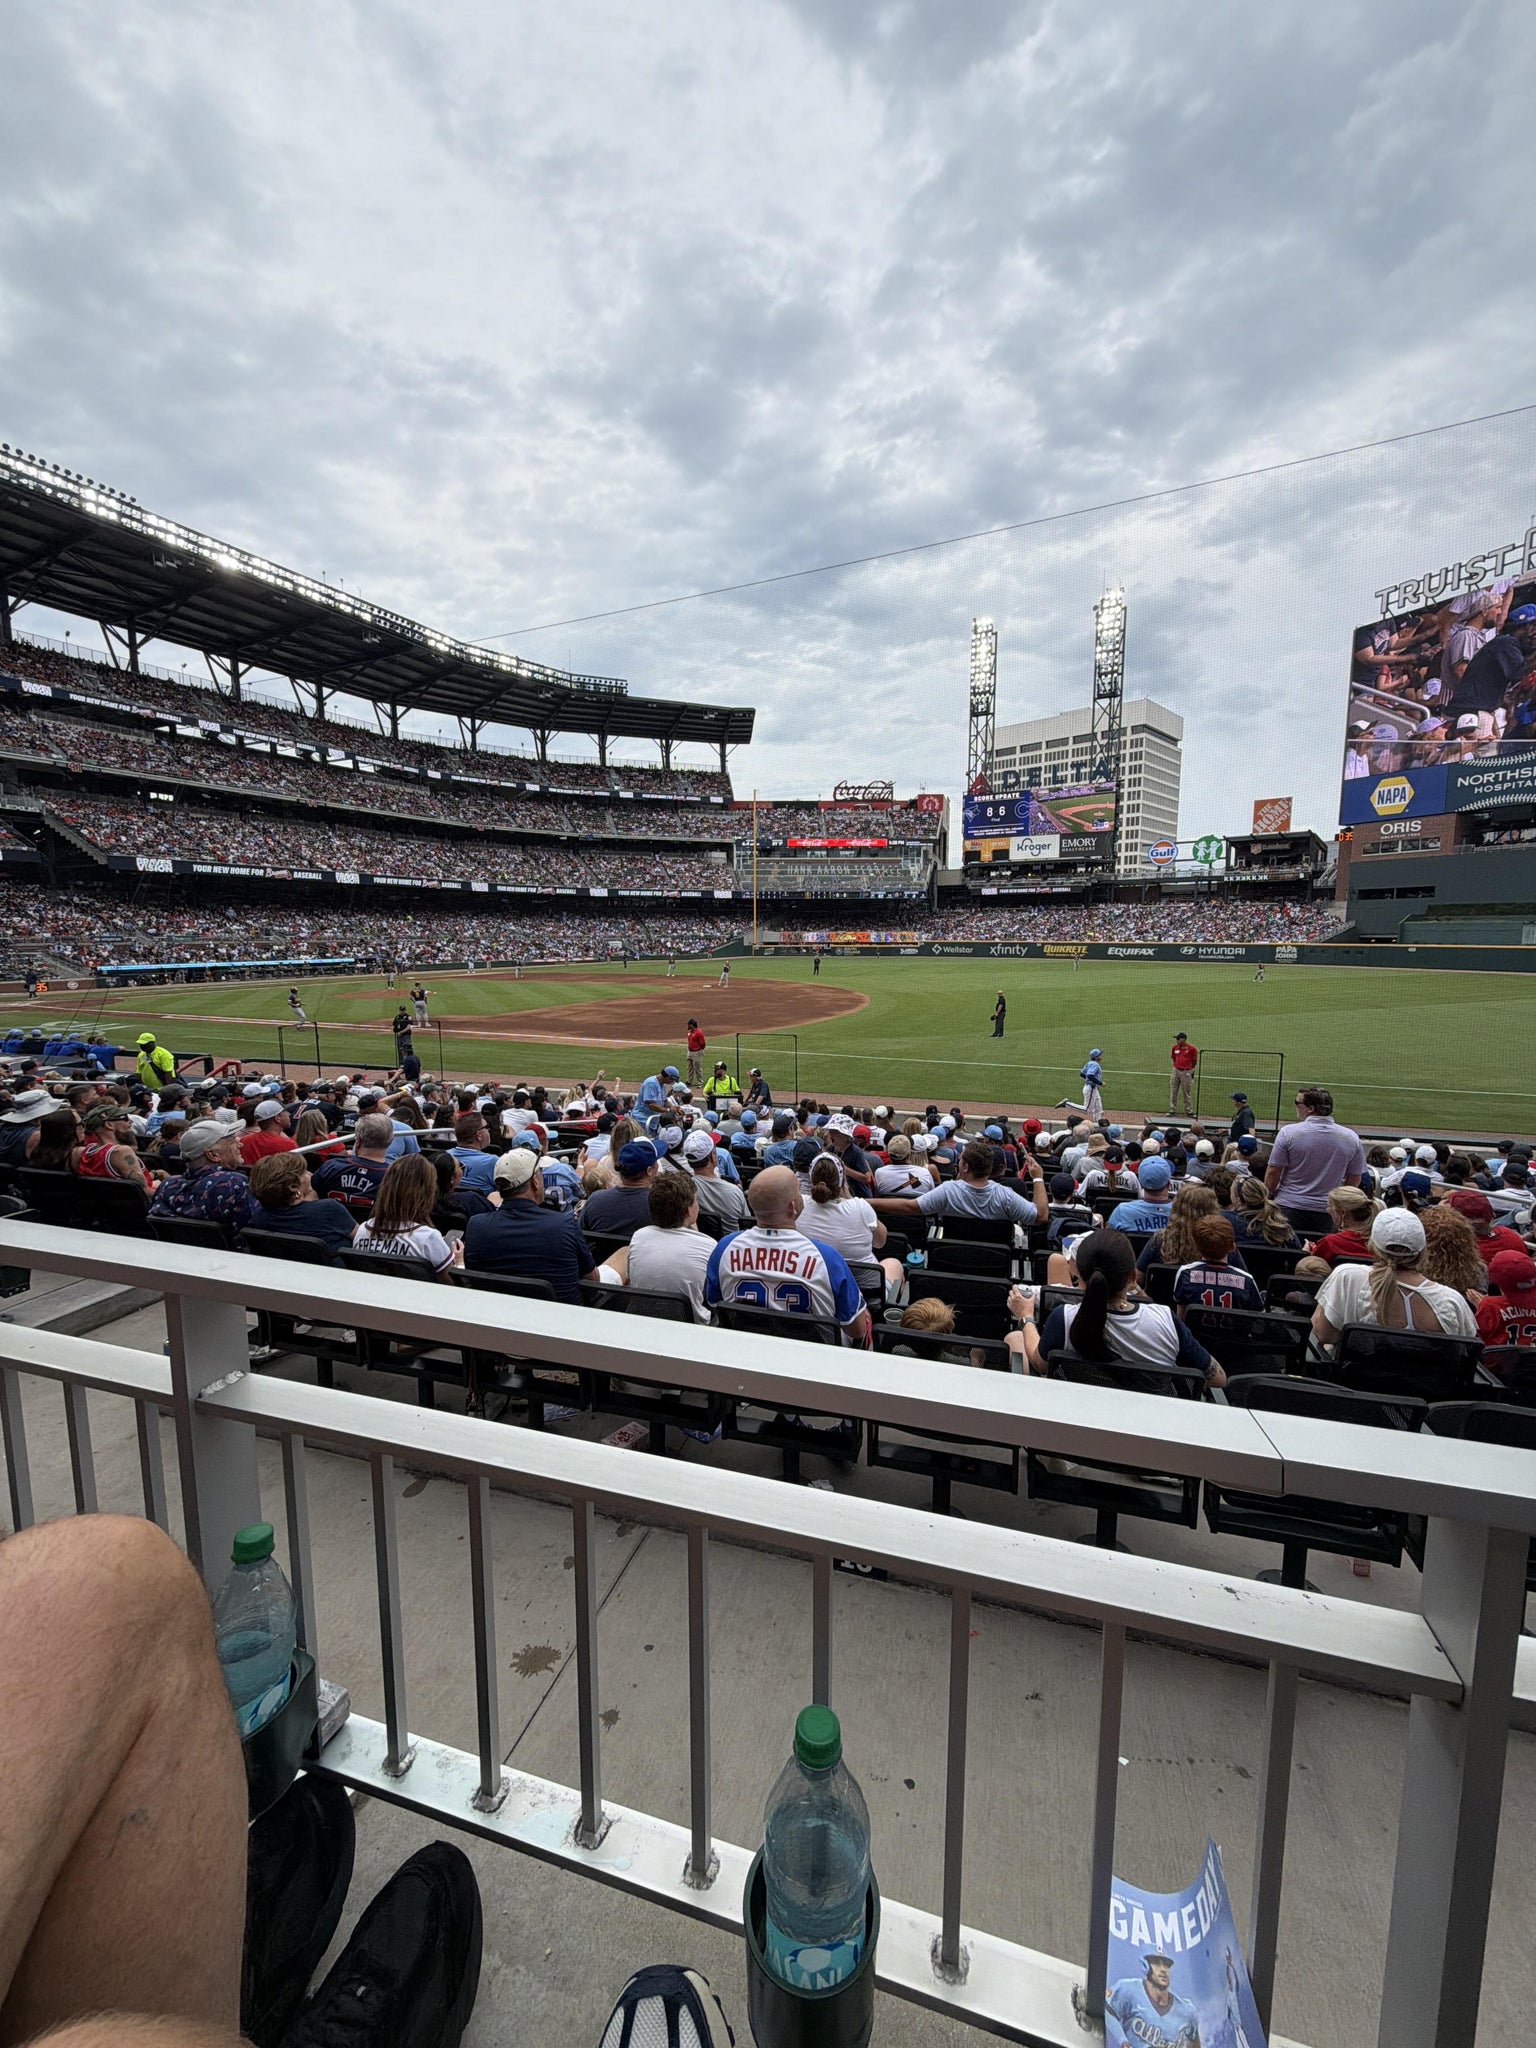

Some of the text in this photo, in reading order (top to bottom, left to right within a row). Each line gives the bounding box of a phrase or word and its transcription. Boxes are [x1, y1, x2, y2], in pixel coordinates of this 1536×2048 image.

[1375, 543, 1515, 615] TRUIST
[69, 693, 86, 702] YOUR
[101, 700, 118, 709] HOME
[119, 703, 131, 711] FOR
[156, 711, 182, 723] BASEBALL
[1002, 760, 1111, 791] DELTA
[995, 792, 1020, 800] UPDATE
[1377, 786, 1407, 806] NAPA
[986, 805, 1006, 817] 8 6
[1253, 798, 1292, 833] HOME
[1257, 802, 1273, 816] THE
[1267, 810, 1291, 832] DEPOT
[1380, 820, 1422, 835] ORIS
[1017, 838, 1052, 857] Kroger
[1062, 837, 1097, 848] EMORY
[1150, 846, 1176, 859] Gulf
[136, 857, 172, 866] BRAVES
[137, 864, 173, 873] VISION
[193, 864, 211, 873] YOUR
[213, 865, 229, 874] NEW
[230, 866, 250, 875] HOME
[250, 867, 264, 876] FOR
[293, 871, 322, 880] BASEBALL
[787, 865, 812, 875] HANK
[817, 865, 850, 875] AARON
[399, 878, 412, 886] HOME
[943, 945, 974, 954] Wellstar
[989, 943, 1028, 956] xfinity
[1043, 944, 1088, 954] QUIKRETE
[1107, 946, 1156, 957] EQUIFAX
[1199, 947, 1246, 955] HYUNDAI
[1276, 945, 1297, 953] PAPA
[36, 982, 48, 992] 35
[341, 1174, 374, 1192] RILEY
[1096, 1176, 1129, 1187] MAUX
[1135, 1215, 1168, 1232] HARR
[359, 1238, 410, 1256] FREEMAN
[730, 1247, 817, 1280] HARRIS II
[1109, 1847, 1221, 1953] GAMEDAY
